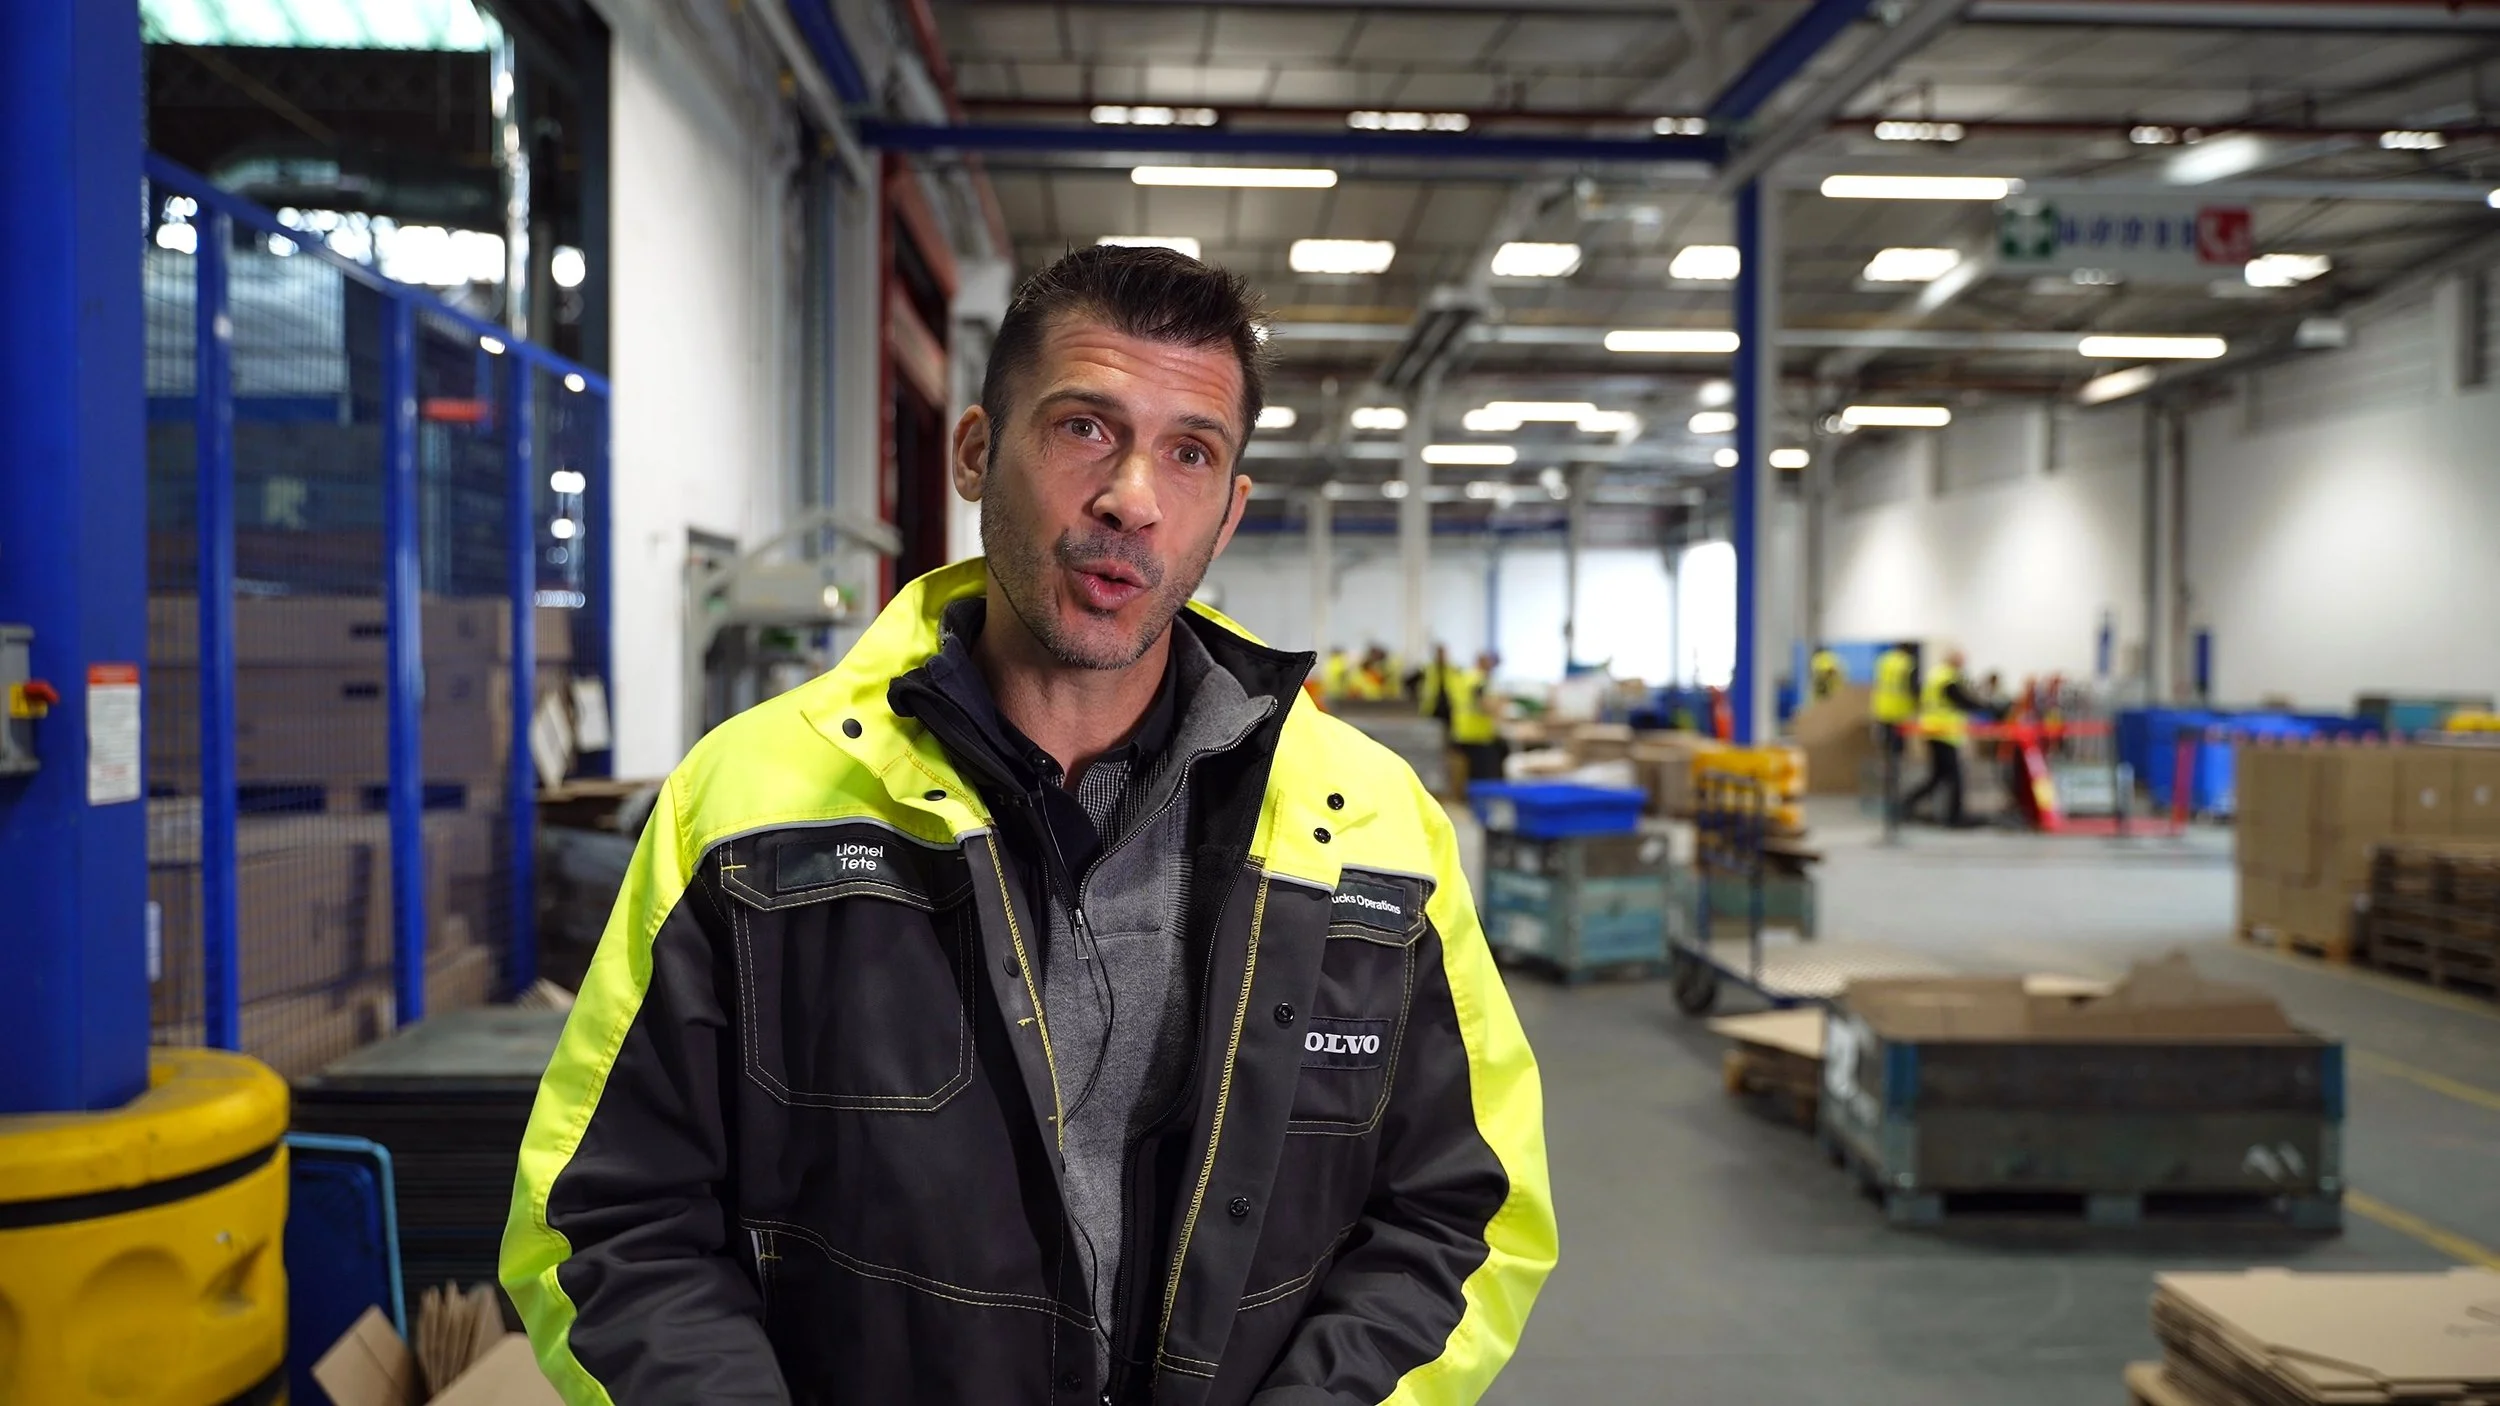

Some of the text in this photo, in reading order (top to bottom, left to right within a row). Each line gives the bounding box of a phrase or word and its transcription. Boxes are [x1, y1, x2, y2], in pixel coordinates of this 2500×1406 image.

[836, 843, 883, 857] Lionel
[840, 858, 877, 871] Tete
[1331, 893, 1401, 914] ucks Operations
[1304, 1032, 1380, 1054] OLVO
